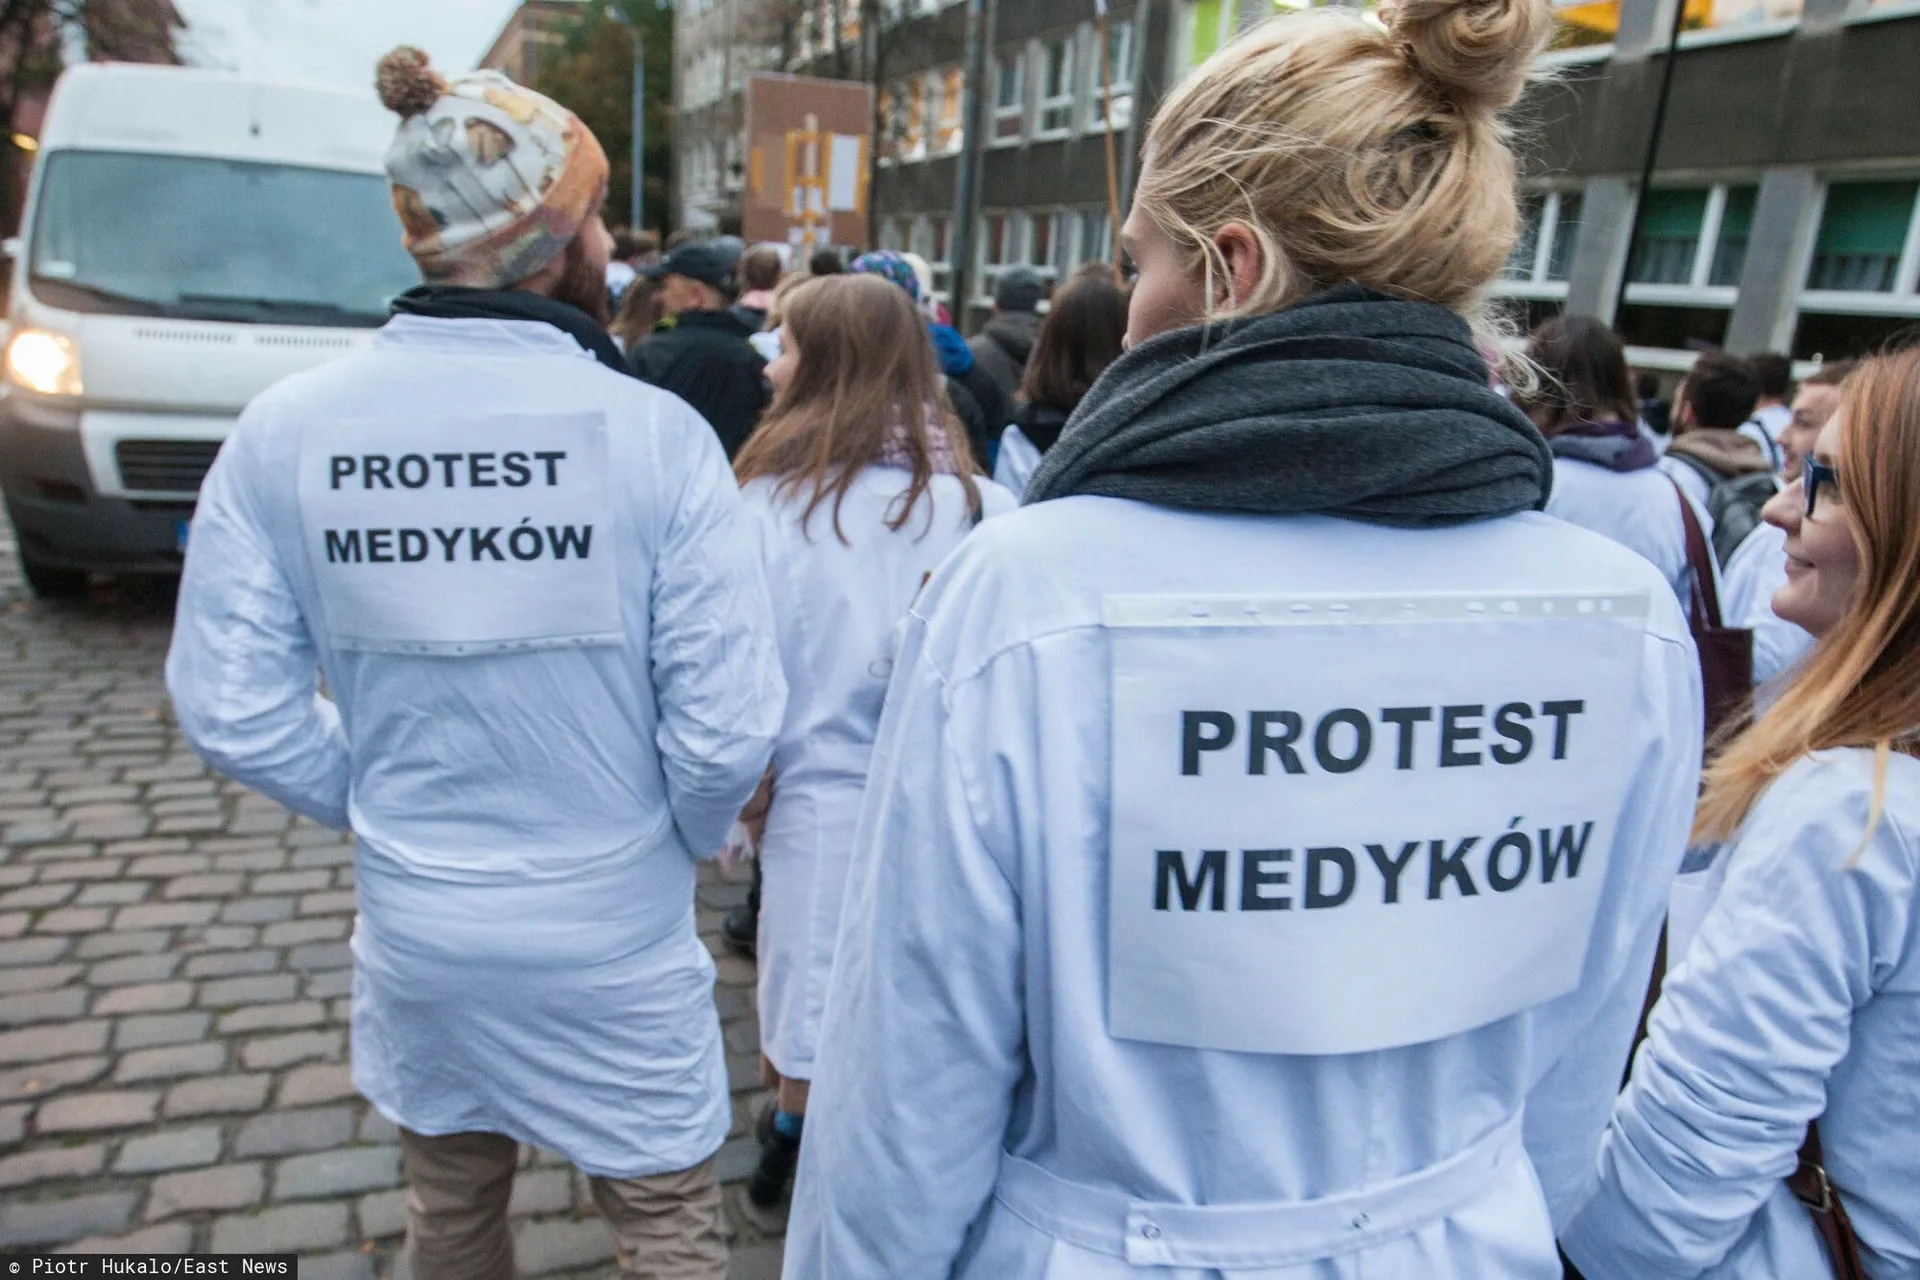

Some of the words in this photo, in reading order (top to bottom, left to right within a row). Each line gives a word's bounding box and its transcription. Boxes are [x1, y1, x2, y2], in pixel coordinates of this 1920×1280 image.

[330, 450, 568, 490] PROTEST
[323, 516, 594, 564] MEDYKÓW
[1179, 699, 1586, 776] PROTEST
[1151, 815, 1595, 913] MEDYKÓW
